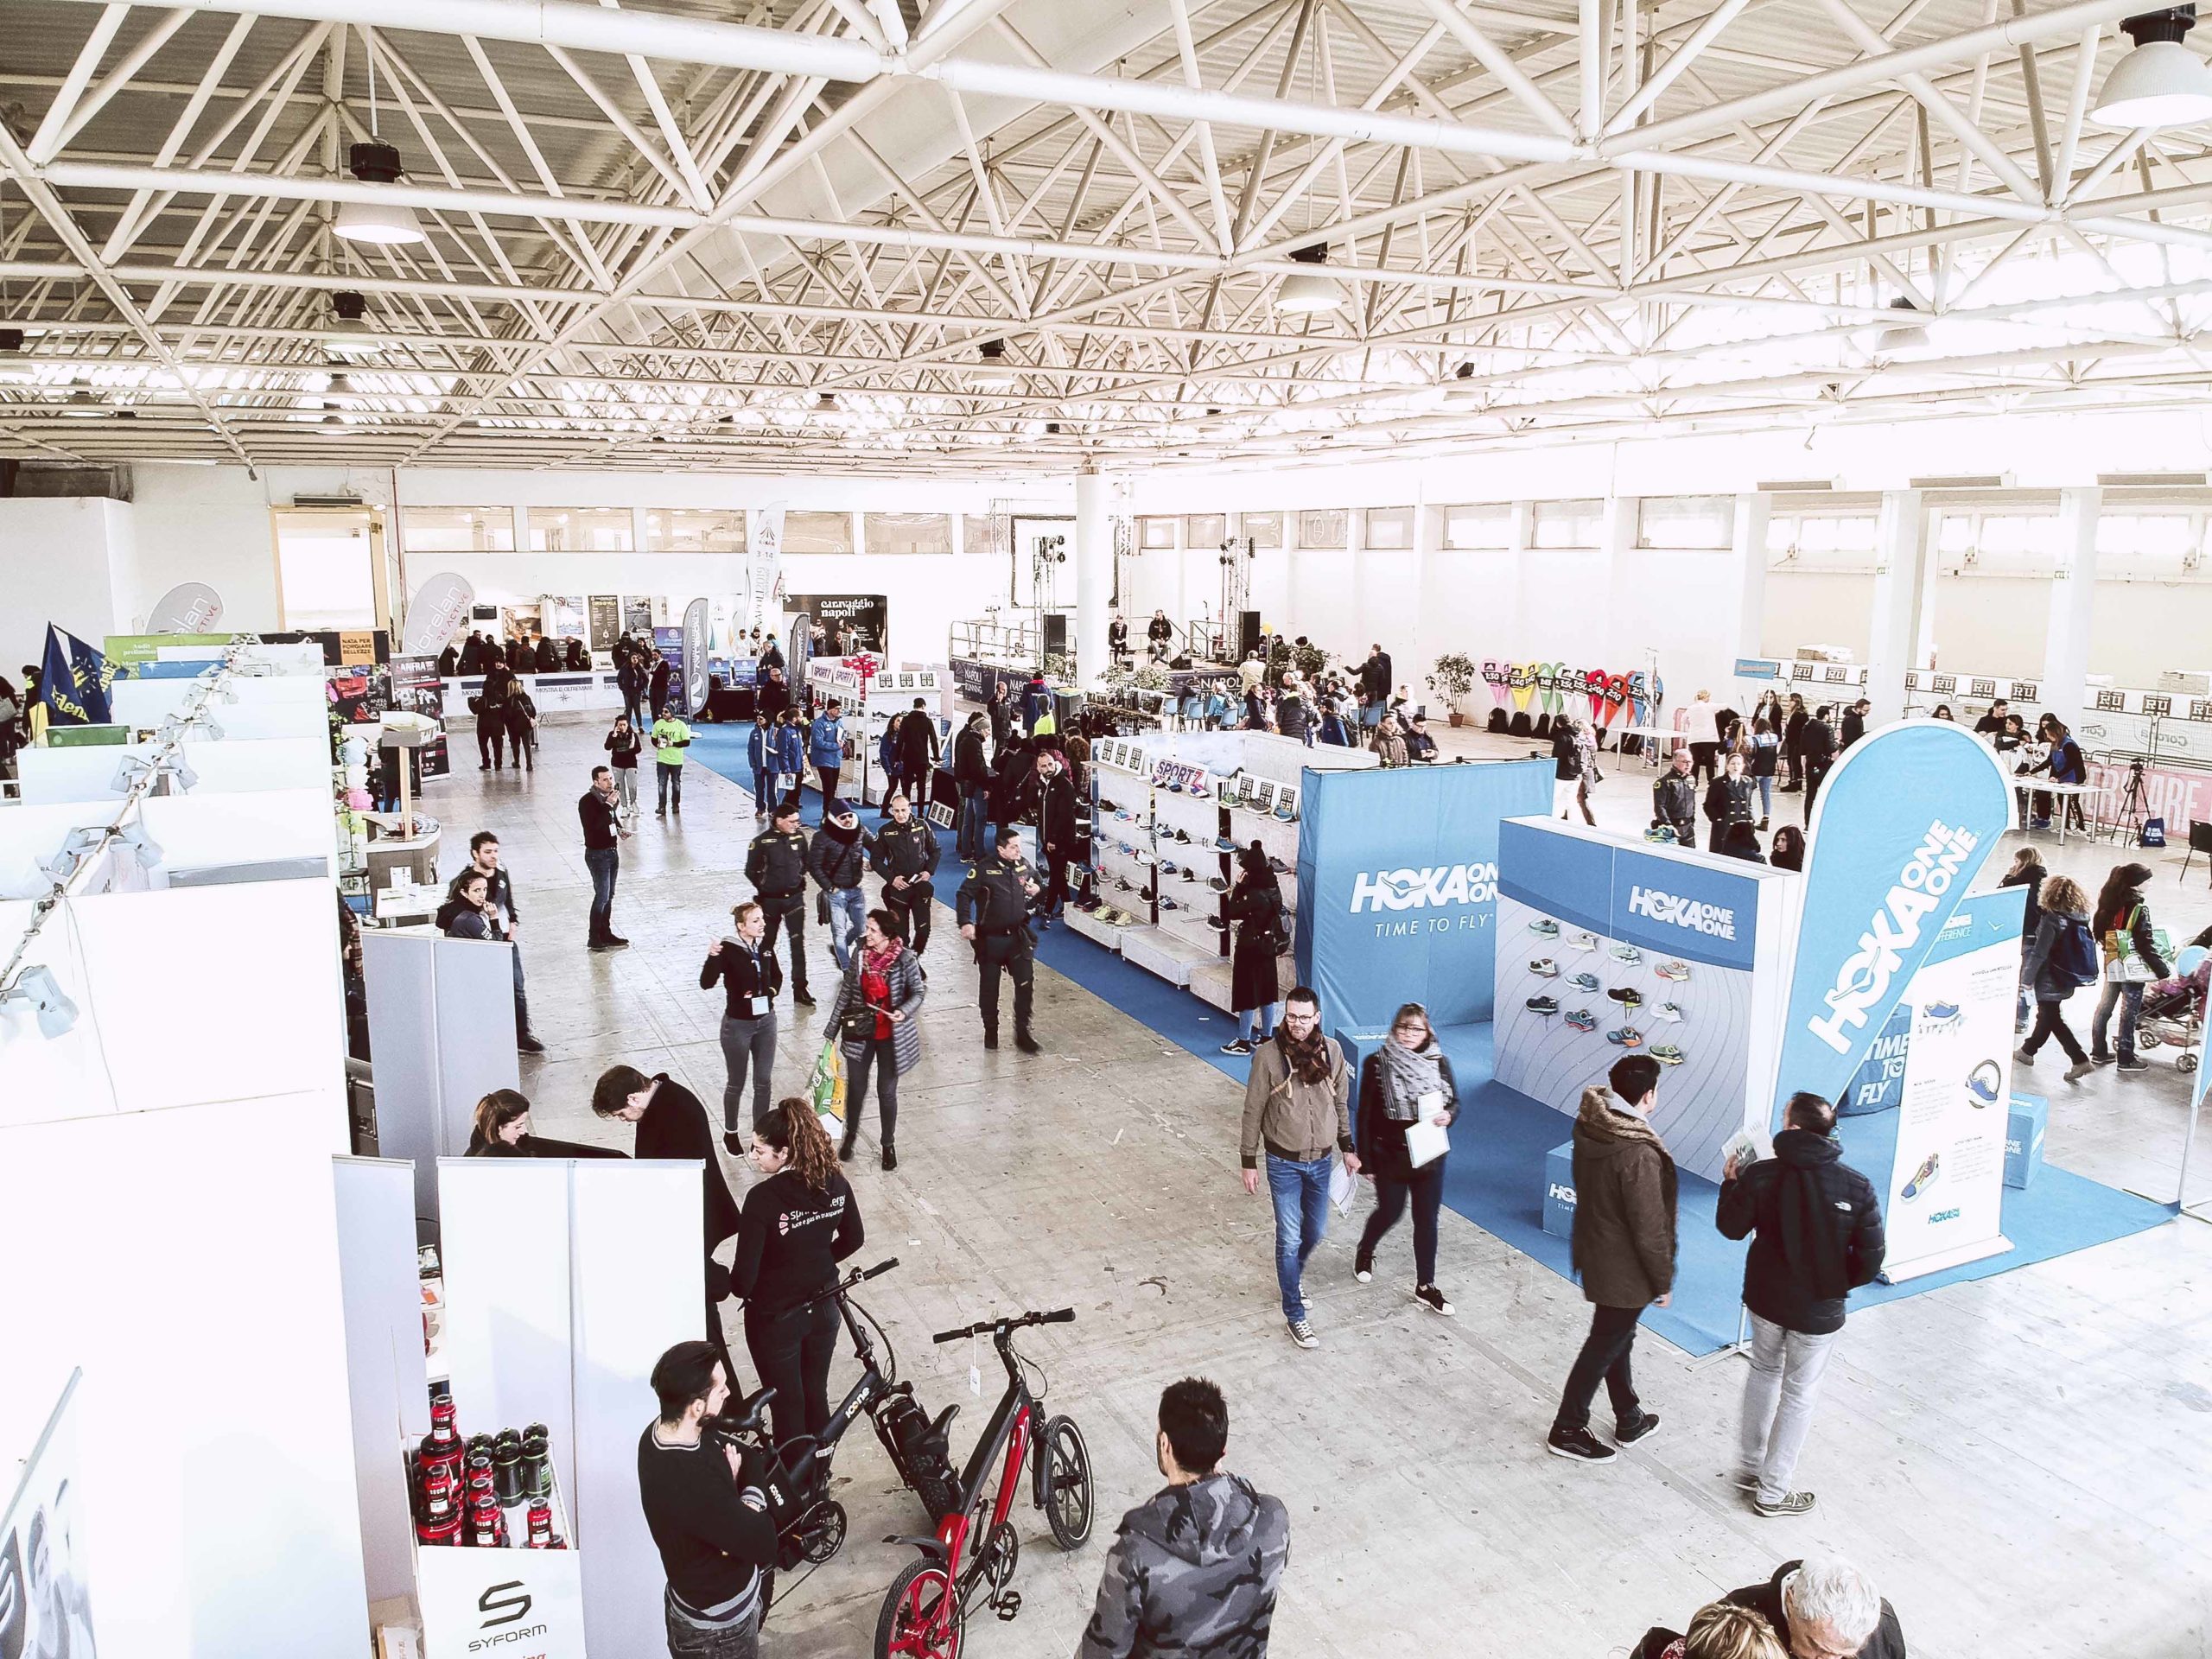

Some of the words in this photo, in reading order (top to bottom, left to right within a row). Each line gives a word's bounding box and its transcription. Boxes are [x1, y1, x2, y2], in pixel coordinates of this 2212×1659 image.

[821, 598, 874, 609] caravaggio
[821, 607, 856, 619] napoli
[1900, 818, 1954, 889] ONE
[1923, 825, 1980, 897] ONE
[1350, 864, 1469, 913] HOKA
[1628, 885, 1703, 932] HOKA
[1700, 903, 1734, 925] ONE
[1375, 920, 1419, 938] TIME
[1428, 918, 1450, 932] TO
[1459, 913, 1488, 930] FLY
[1702, 918, 1736, 941] ONE
[1807, 884, 1940, 1056] HOKA
[1882, 1055, 1906, 1080] TO
[1856, 1079, 1891, 1106] FLY
[468, 1624, 547, 1652] SYFORM
